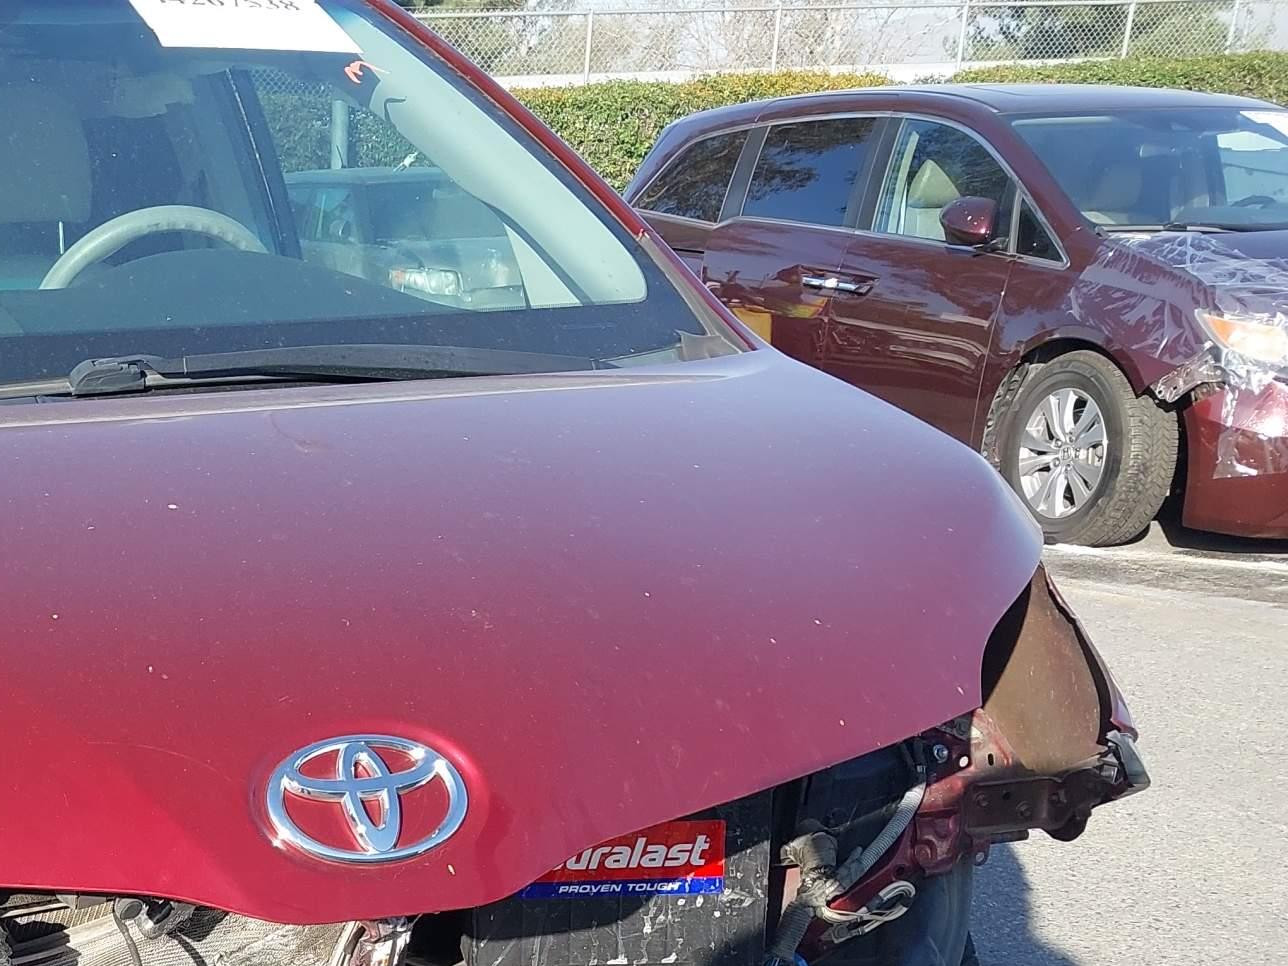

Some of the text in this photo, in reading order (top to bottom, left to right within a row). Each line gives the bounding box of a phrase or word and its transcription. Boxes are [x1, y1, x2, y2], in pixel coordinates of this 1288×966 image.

[553, 834, 711, 871] uralast
[558, 880, 682, 895] PROVEN TOUGH
